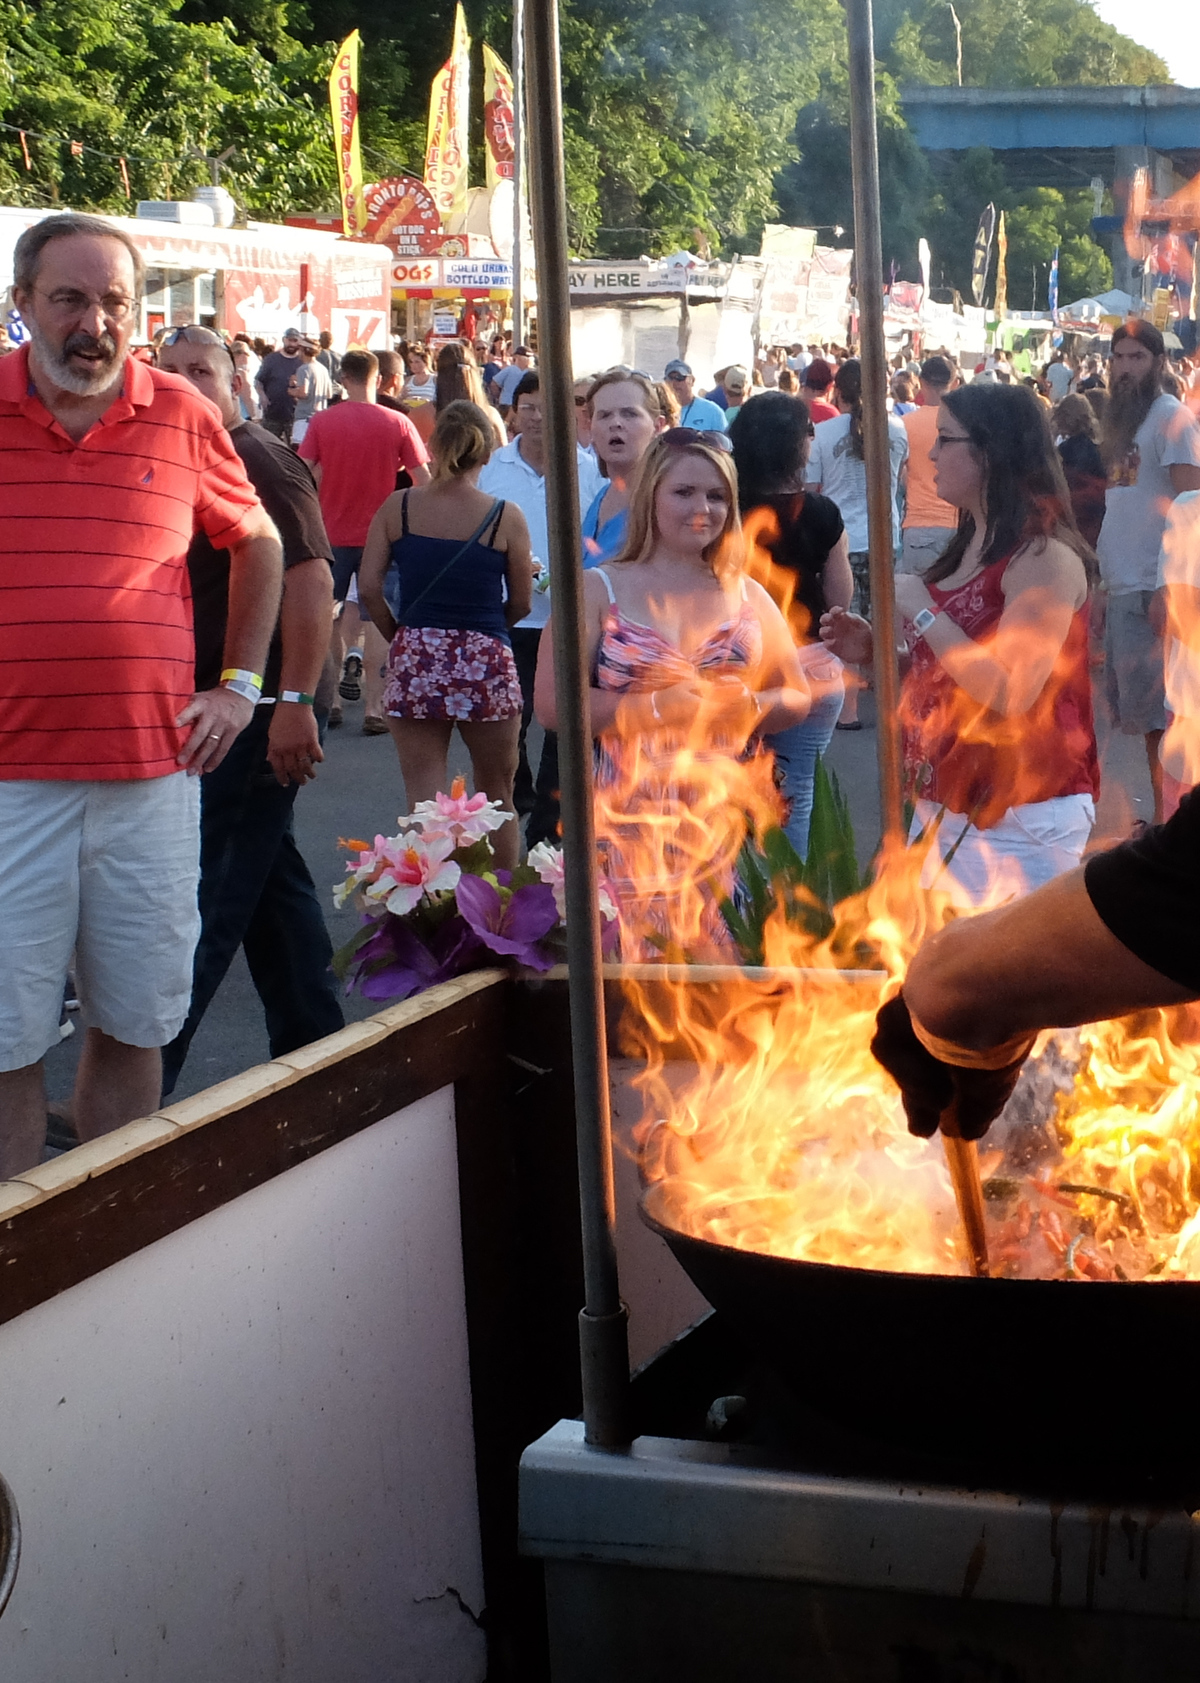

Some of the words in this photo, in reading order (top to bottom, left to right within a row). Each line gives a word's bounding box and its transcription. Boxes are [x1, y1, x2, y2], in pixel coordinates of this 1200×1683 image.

[367, 183, 406, 221] PRONTO
[393, 265, 433, 281] OGS
[446, 275, 490, 285] BOTTLED
[569, 273, 587, 288] AY
[594, 273, 641, 288] HERE
